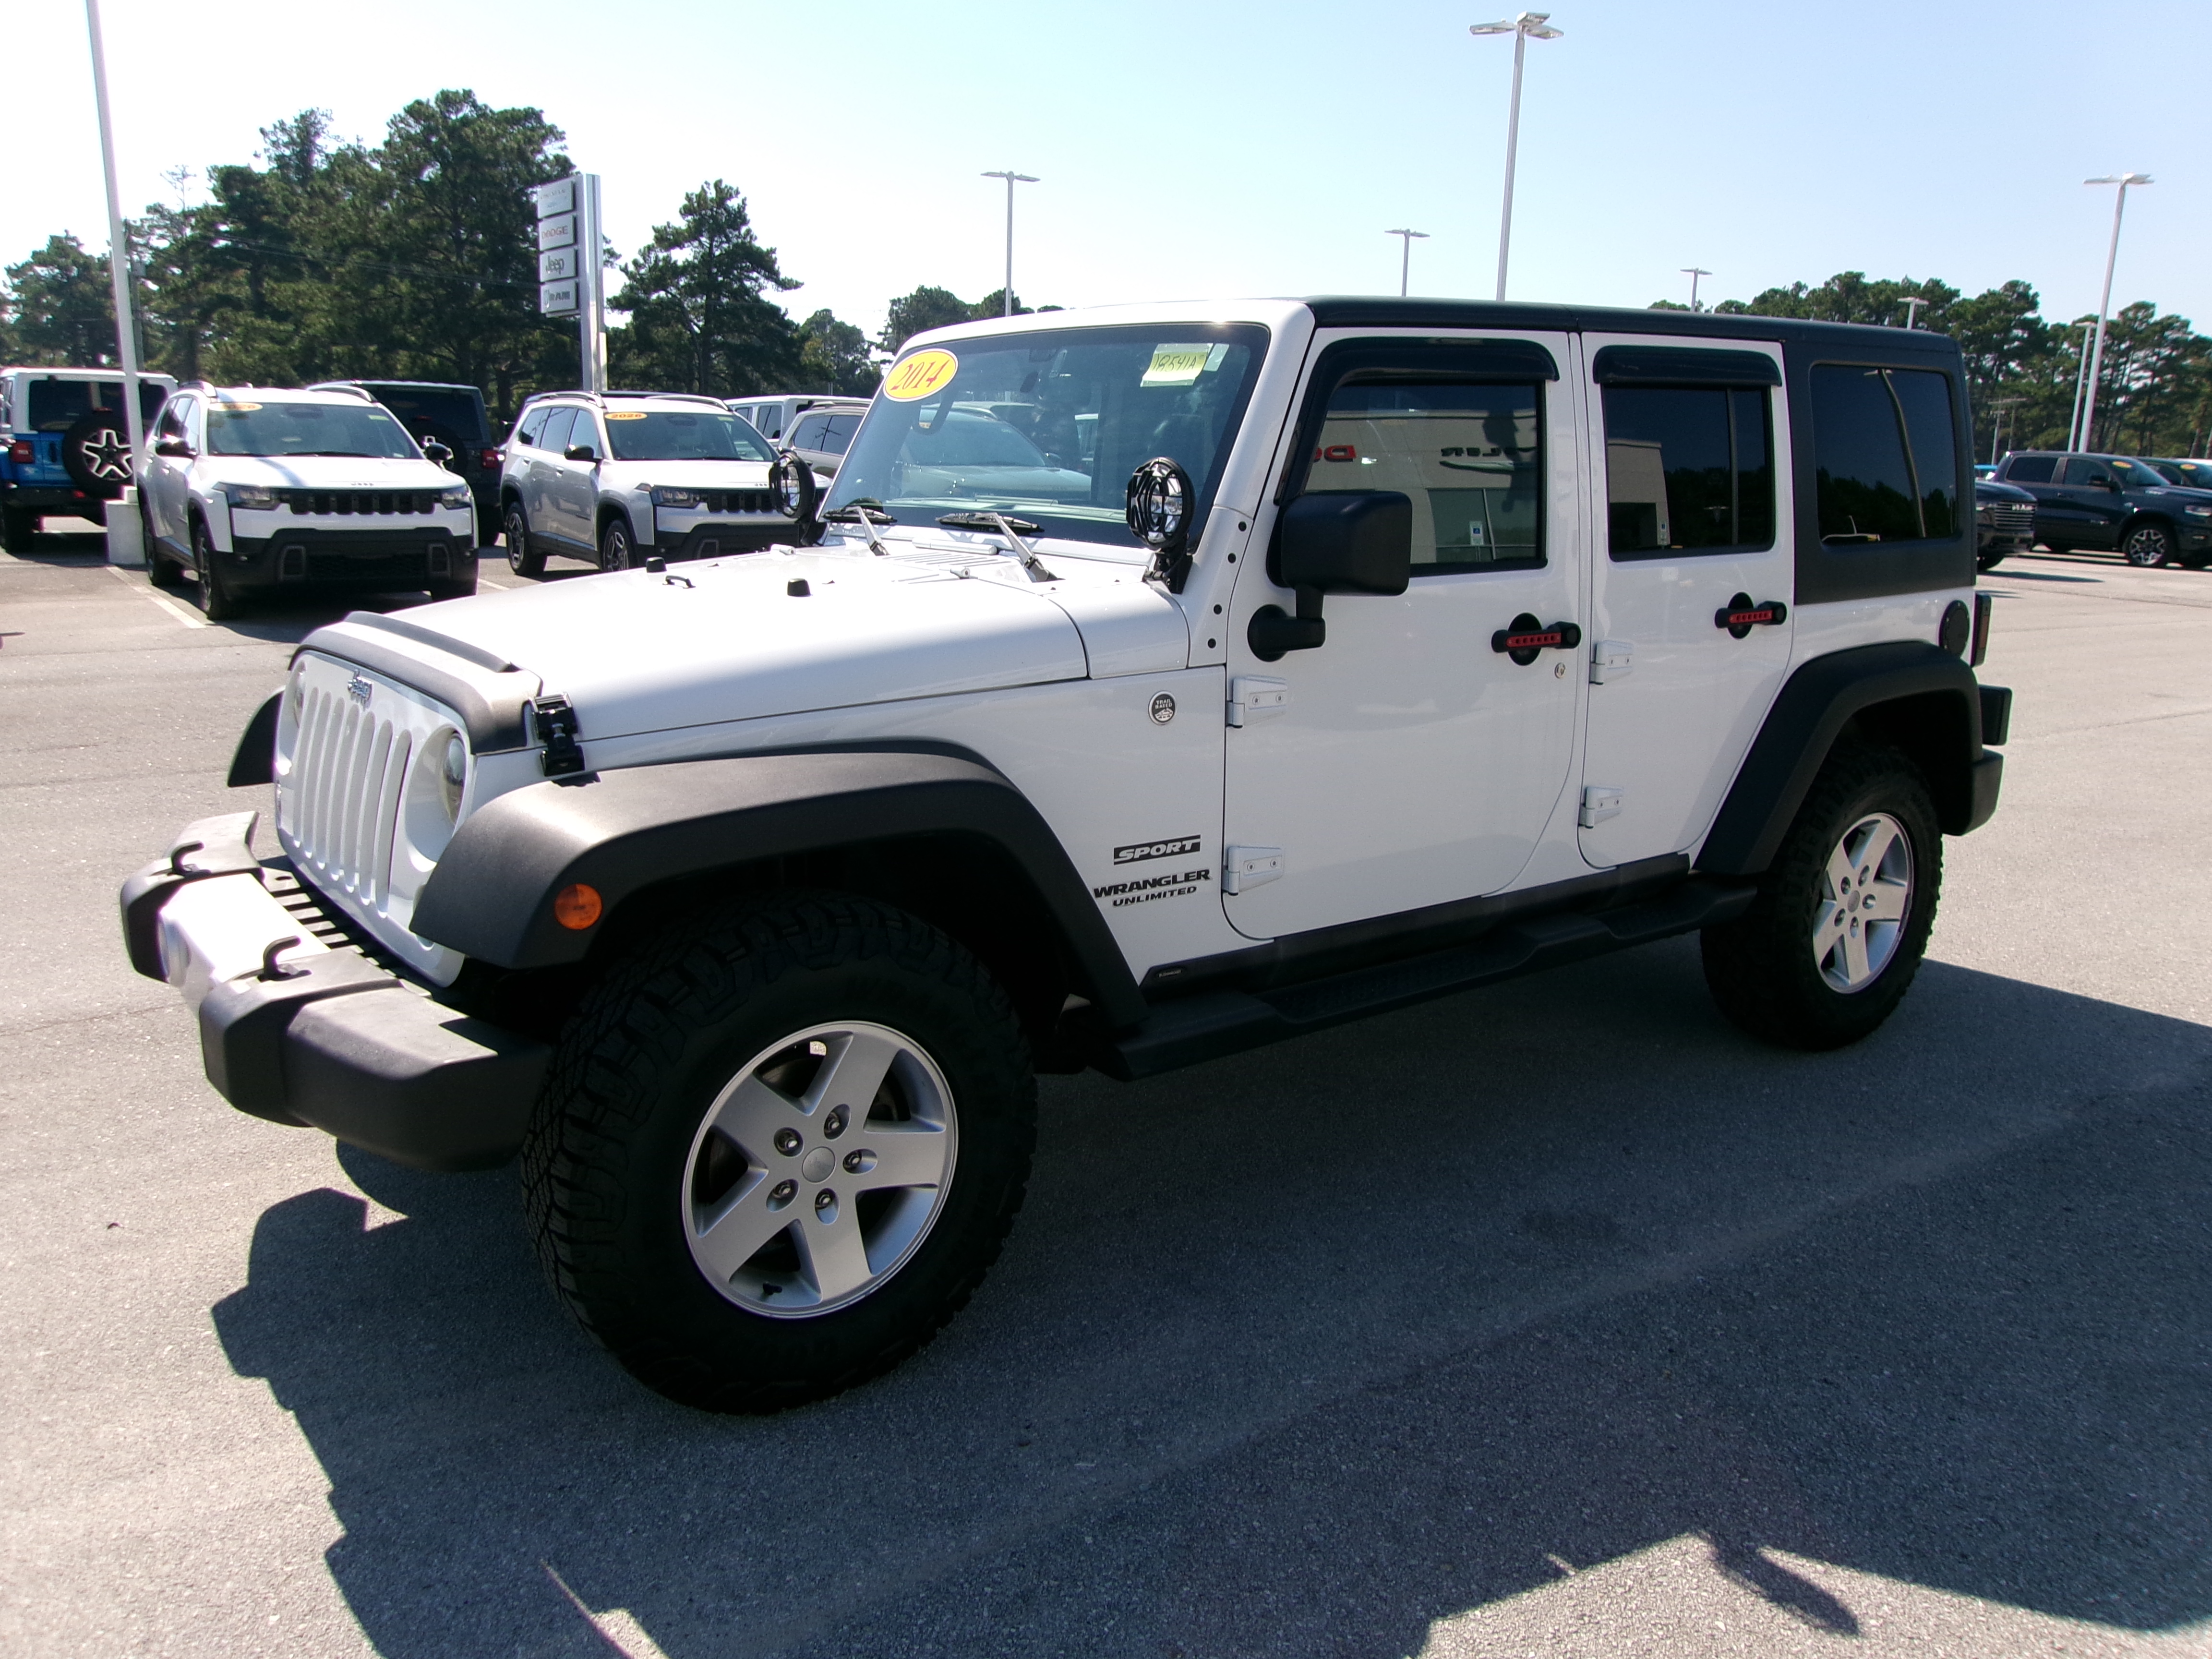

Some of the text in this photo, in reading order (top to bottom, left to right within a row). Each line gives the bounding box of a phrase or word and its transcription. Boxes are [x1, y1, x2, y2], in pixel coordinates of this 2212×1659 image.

[542, 225, 568, 239] DODGE
[546, 255, 565, 274] Jeep
[890, 360, 950, 390] 2014
[1114, 837, 1201, 863] SPORT
[1094, 869, 1211, 898] WRANGLER
[1113, 886, 1197, 906] UNLIMITED
